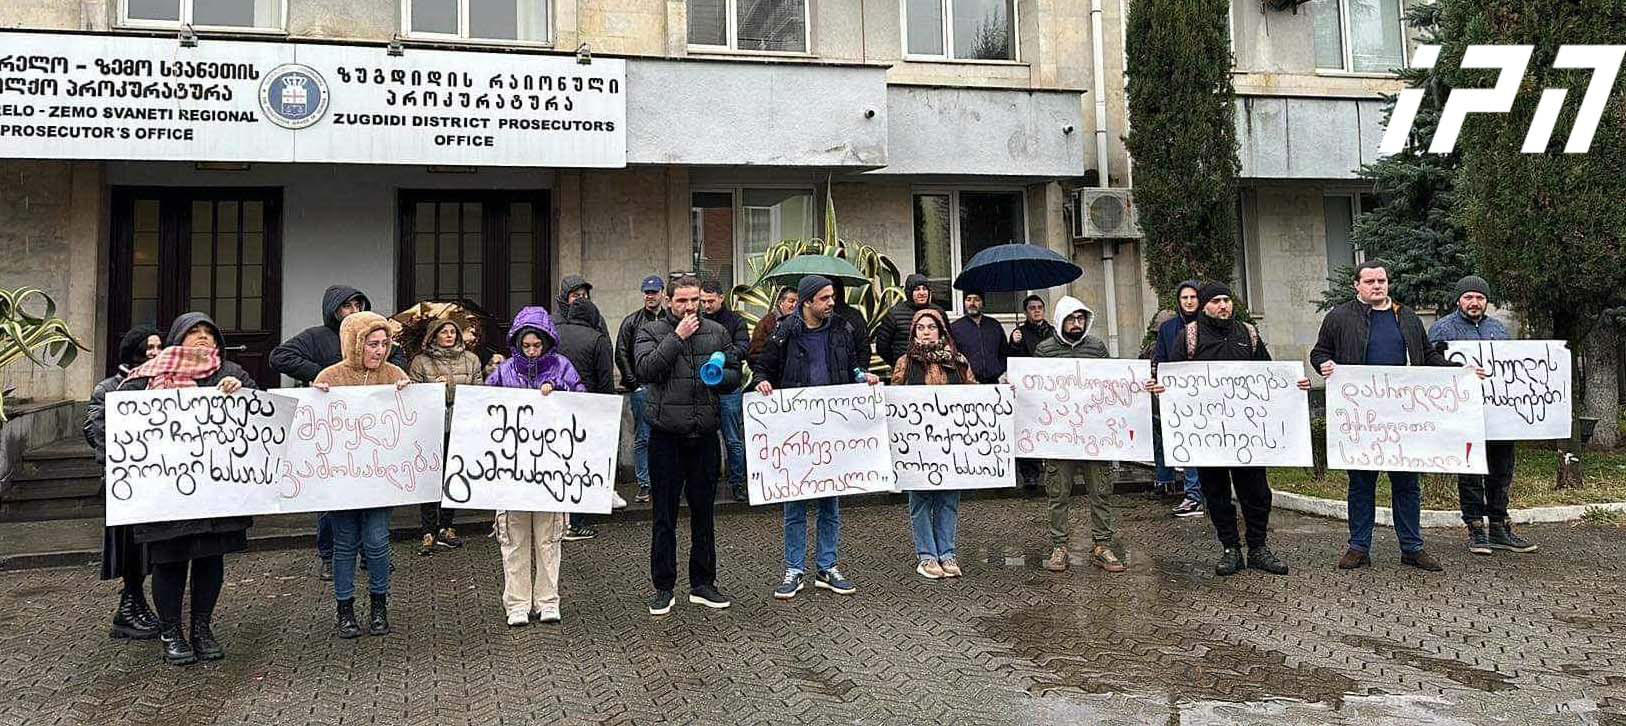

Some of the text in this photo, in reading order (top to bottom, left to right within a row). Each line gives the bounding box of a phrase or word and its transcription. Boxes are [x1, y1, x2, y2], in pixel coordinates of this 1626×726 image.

[95, 59, 152, 77] ზემო
[160, 61, 260, 81] სვანეთის
[337, 67, 619, 95] ზუგდიდის რაიონული
[0, 77, 233, 101] ლქო პროკურატურა
[386, 89, 573, 112] პროკურატურა
[0, 104, 34, 117] ELO
[49, 106, 98, 118] ZEMO
[103, 107, 173, 120] SVANETI
[179, 109, 259, 123] REGIONAL
[333, 113, 406, 127] ZUGDIDI
[412, 116, 491, 129] DISTRICT
[0, 125, 194, 141] PROSECUTOR'S OFFICE
[434, 134, 494, 147] OFFICE
[1161, 363, 1288, 401] თავისუფლება
[1342, 373, 1470, 413] დასრულდეს
[117, 389, 275, 428] თავისუფლება
[1168, 398, 1268, 430] კაკოს და
[108, 428, 164, 463] კაკო
[486, 404, 587, 460] შეწყდეს
[889, 432, 921, 455] აკო
[111, 453, 205, 501] გიორგი
[892, 451, 949, 486] იორგი
